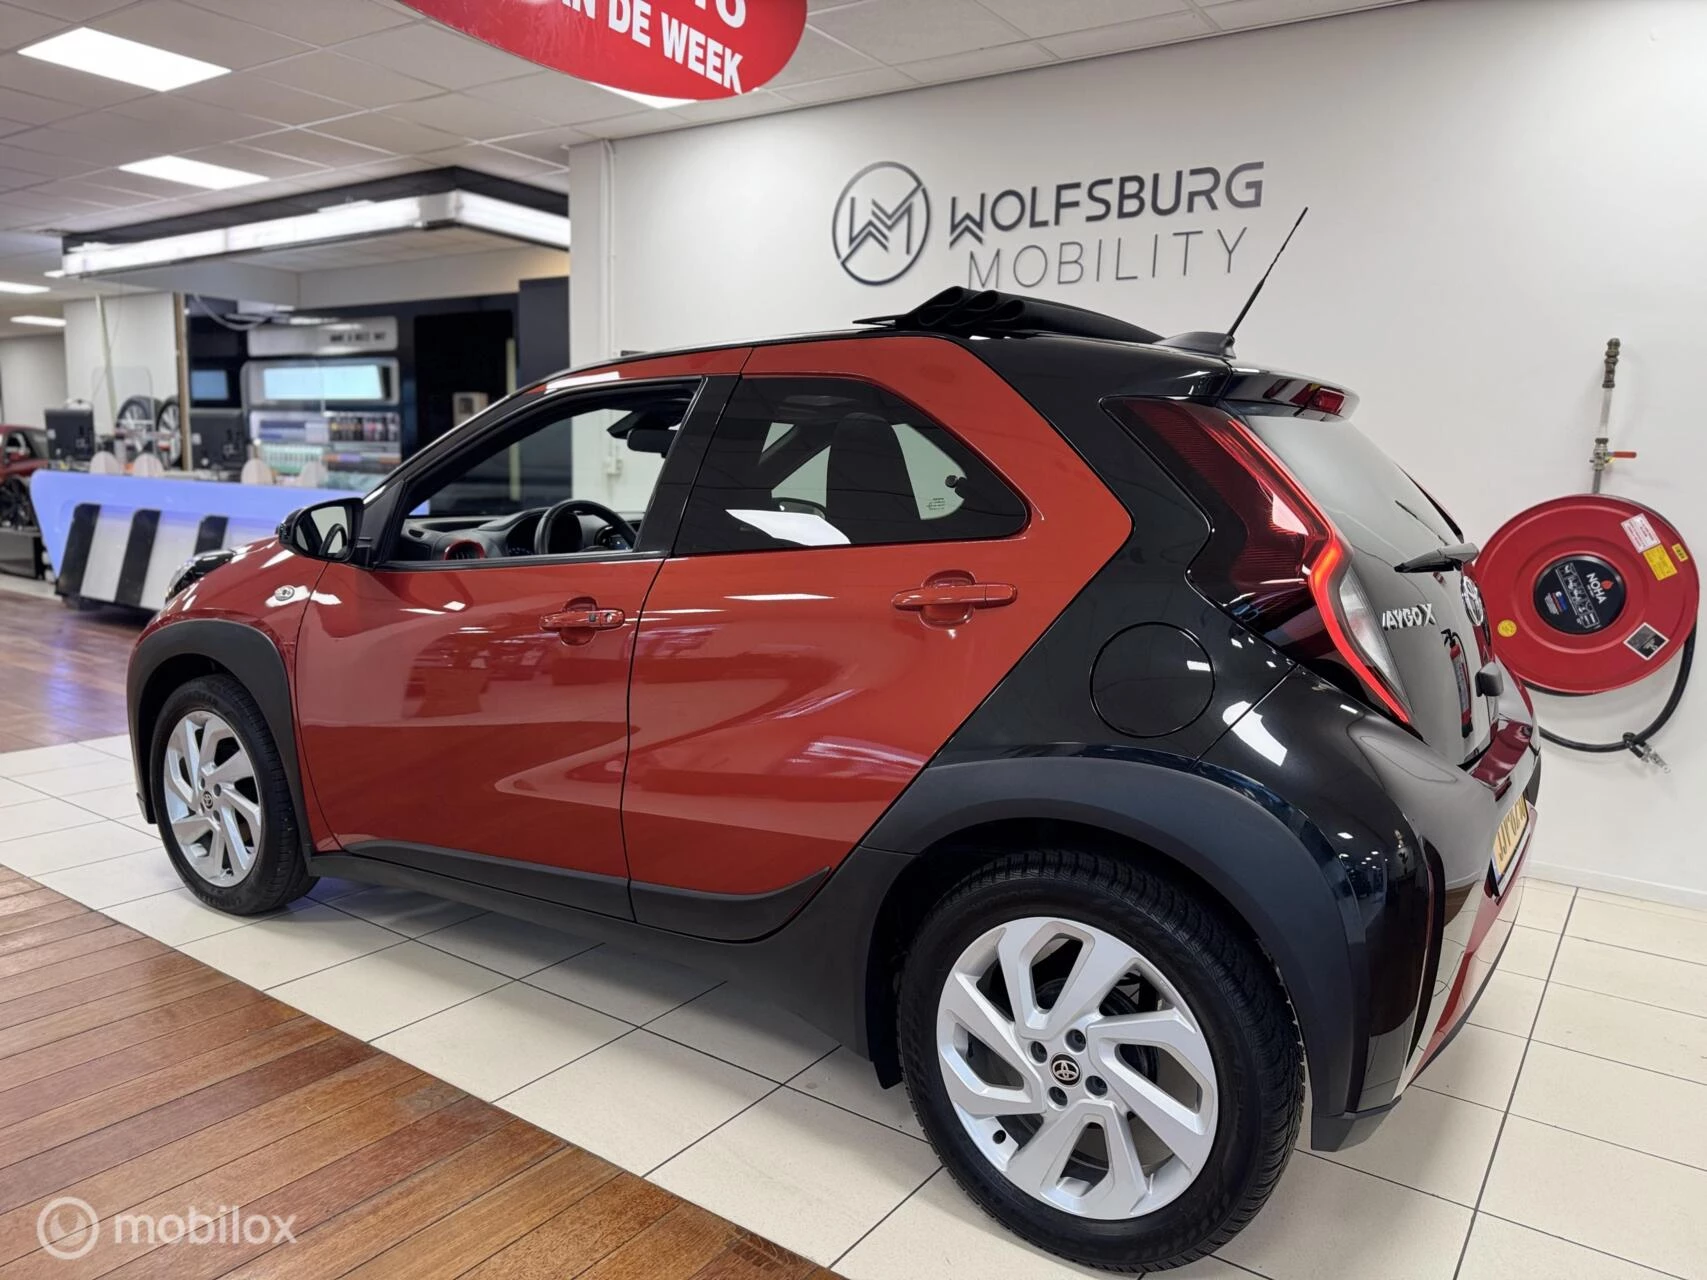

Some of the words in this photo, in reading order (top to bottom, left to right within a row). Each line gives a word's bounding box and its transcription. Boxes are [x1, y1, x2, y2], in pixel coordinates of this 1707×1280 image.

[608, 0, 651, 48] DE
[660, 12, 744, 95] WEEK
[949, 161, 1265, 249] WOLFSBURG
[967, 227, 1248, 289] MOBILITY
[1420, 603, 1437, 628] X
[1586, 572, 1608, 604] NOHA
